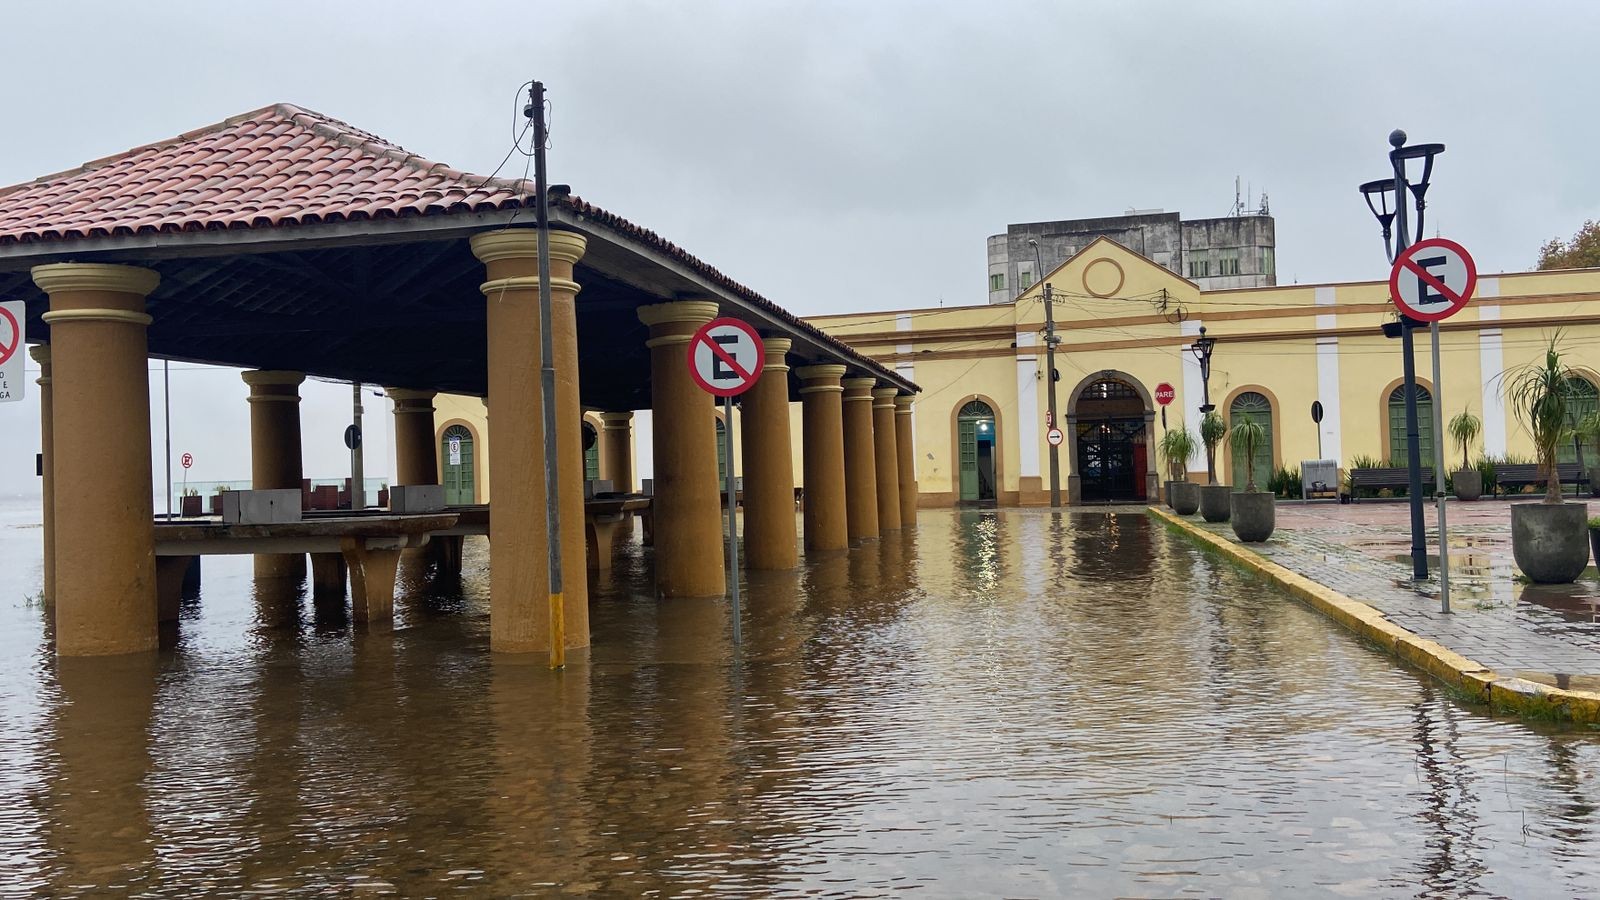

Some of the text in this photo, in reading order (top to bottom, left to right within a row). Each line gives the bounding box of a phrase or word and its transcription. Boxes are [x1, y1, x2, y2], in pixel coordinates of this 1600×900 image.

[1417, 256, 1448, 305] E
[712, 335, 739, 379] E
[1156, 390, 1173, 398] PARE
